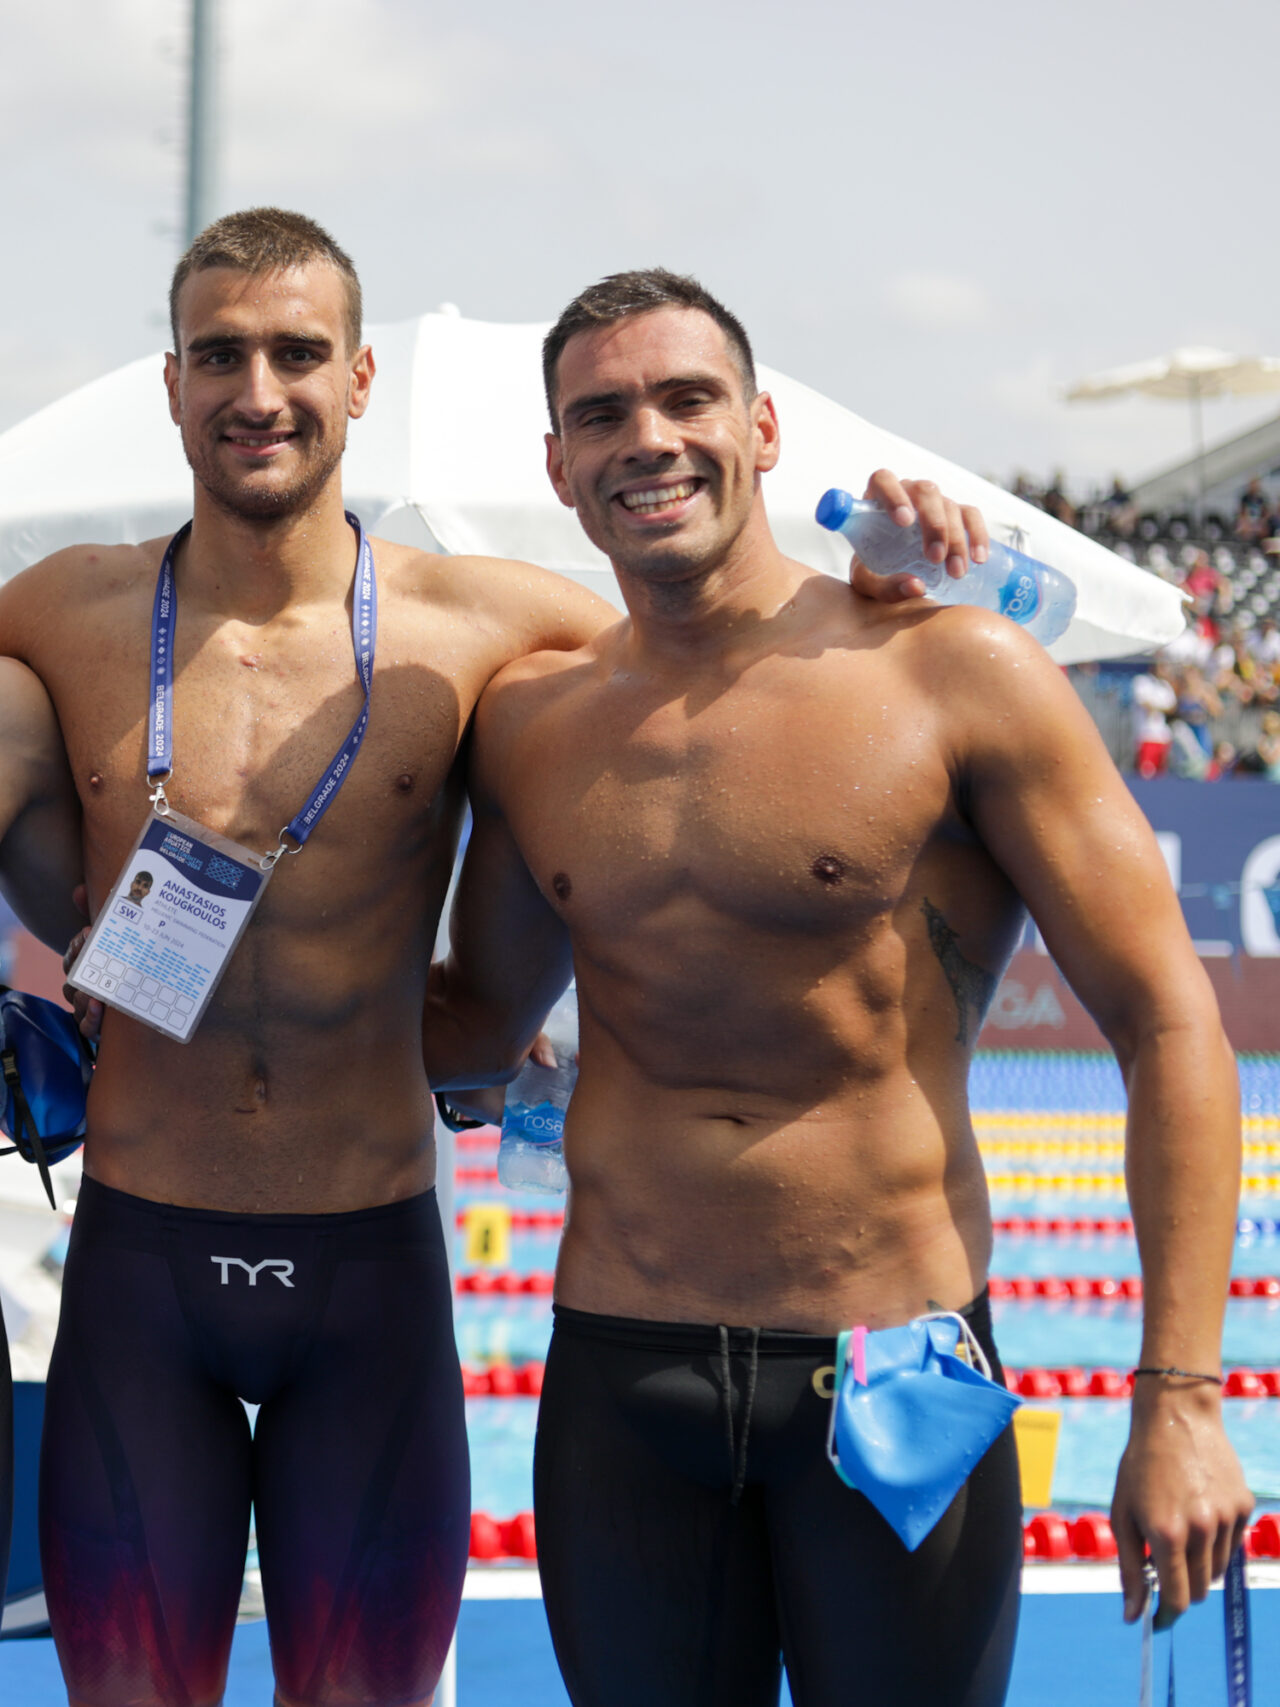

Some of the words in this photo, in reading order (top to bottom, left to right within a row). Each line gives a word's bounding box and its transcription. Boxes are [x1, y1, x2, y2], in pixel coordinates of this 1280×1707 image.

[160, 599, 169, 618] 2024
[1003, 576, 1032, 620] rosa
[156, 684, 165, 732] BELGRADE
[155, 734, 165, 757] 2024
[303, 777, 336, 825] BELGRADE
[333, 753, 349, 778] 2024
[158, 889, 227, 930] KOUGKOULOS
[163, 878, 226, 917] ANASTASIOS
[119, 905, 137, 920] SW
[158, 919, 166, 929] P
[86, 970, 95, 980] 7
[103, 978, 112, 989] 8
[523, 1115, 563, 1133] rosa
[210, 1255, 295, 1287] TYR
